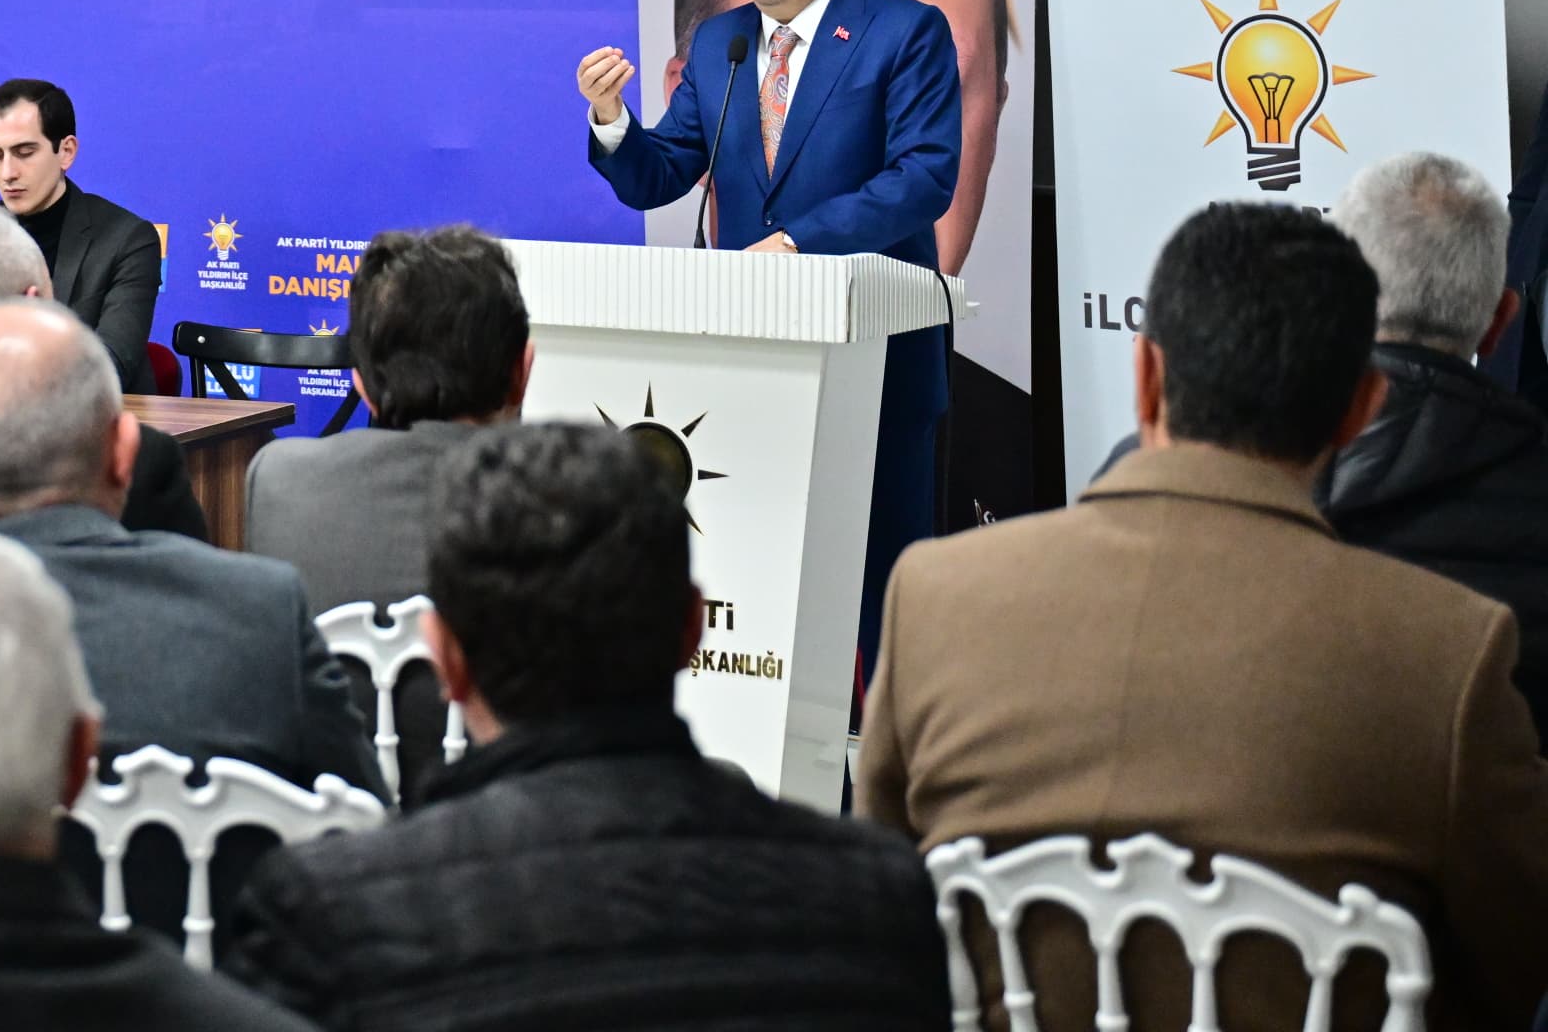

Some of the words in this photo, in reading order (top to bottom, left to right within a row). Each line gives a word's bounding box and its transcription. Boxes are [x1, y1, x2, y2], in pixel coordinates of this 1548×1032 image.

[276, 236, 294, 248] AK
[294, 236, 328, 249] PARTİ
[206, 260, 218, 269] AK
[197, 270, 231, 279] YILDIRIM
[231, 269, 249, 281] İLÇE
[200, 279, 246, 290] BAŞKANLIĞI
[298, 376, 332, 386] YILDIRIM
[300, 386, 348, 398] BAŞKANLIĞI
